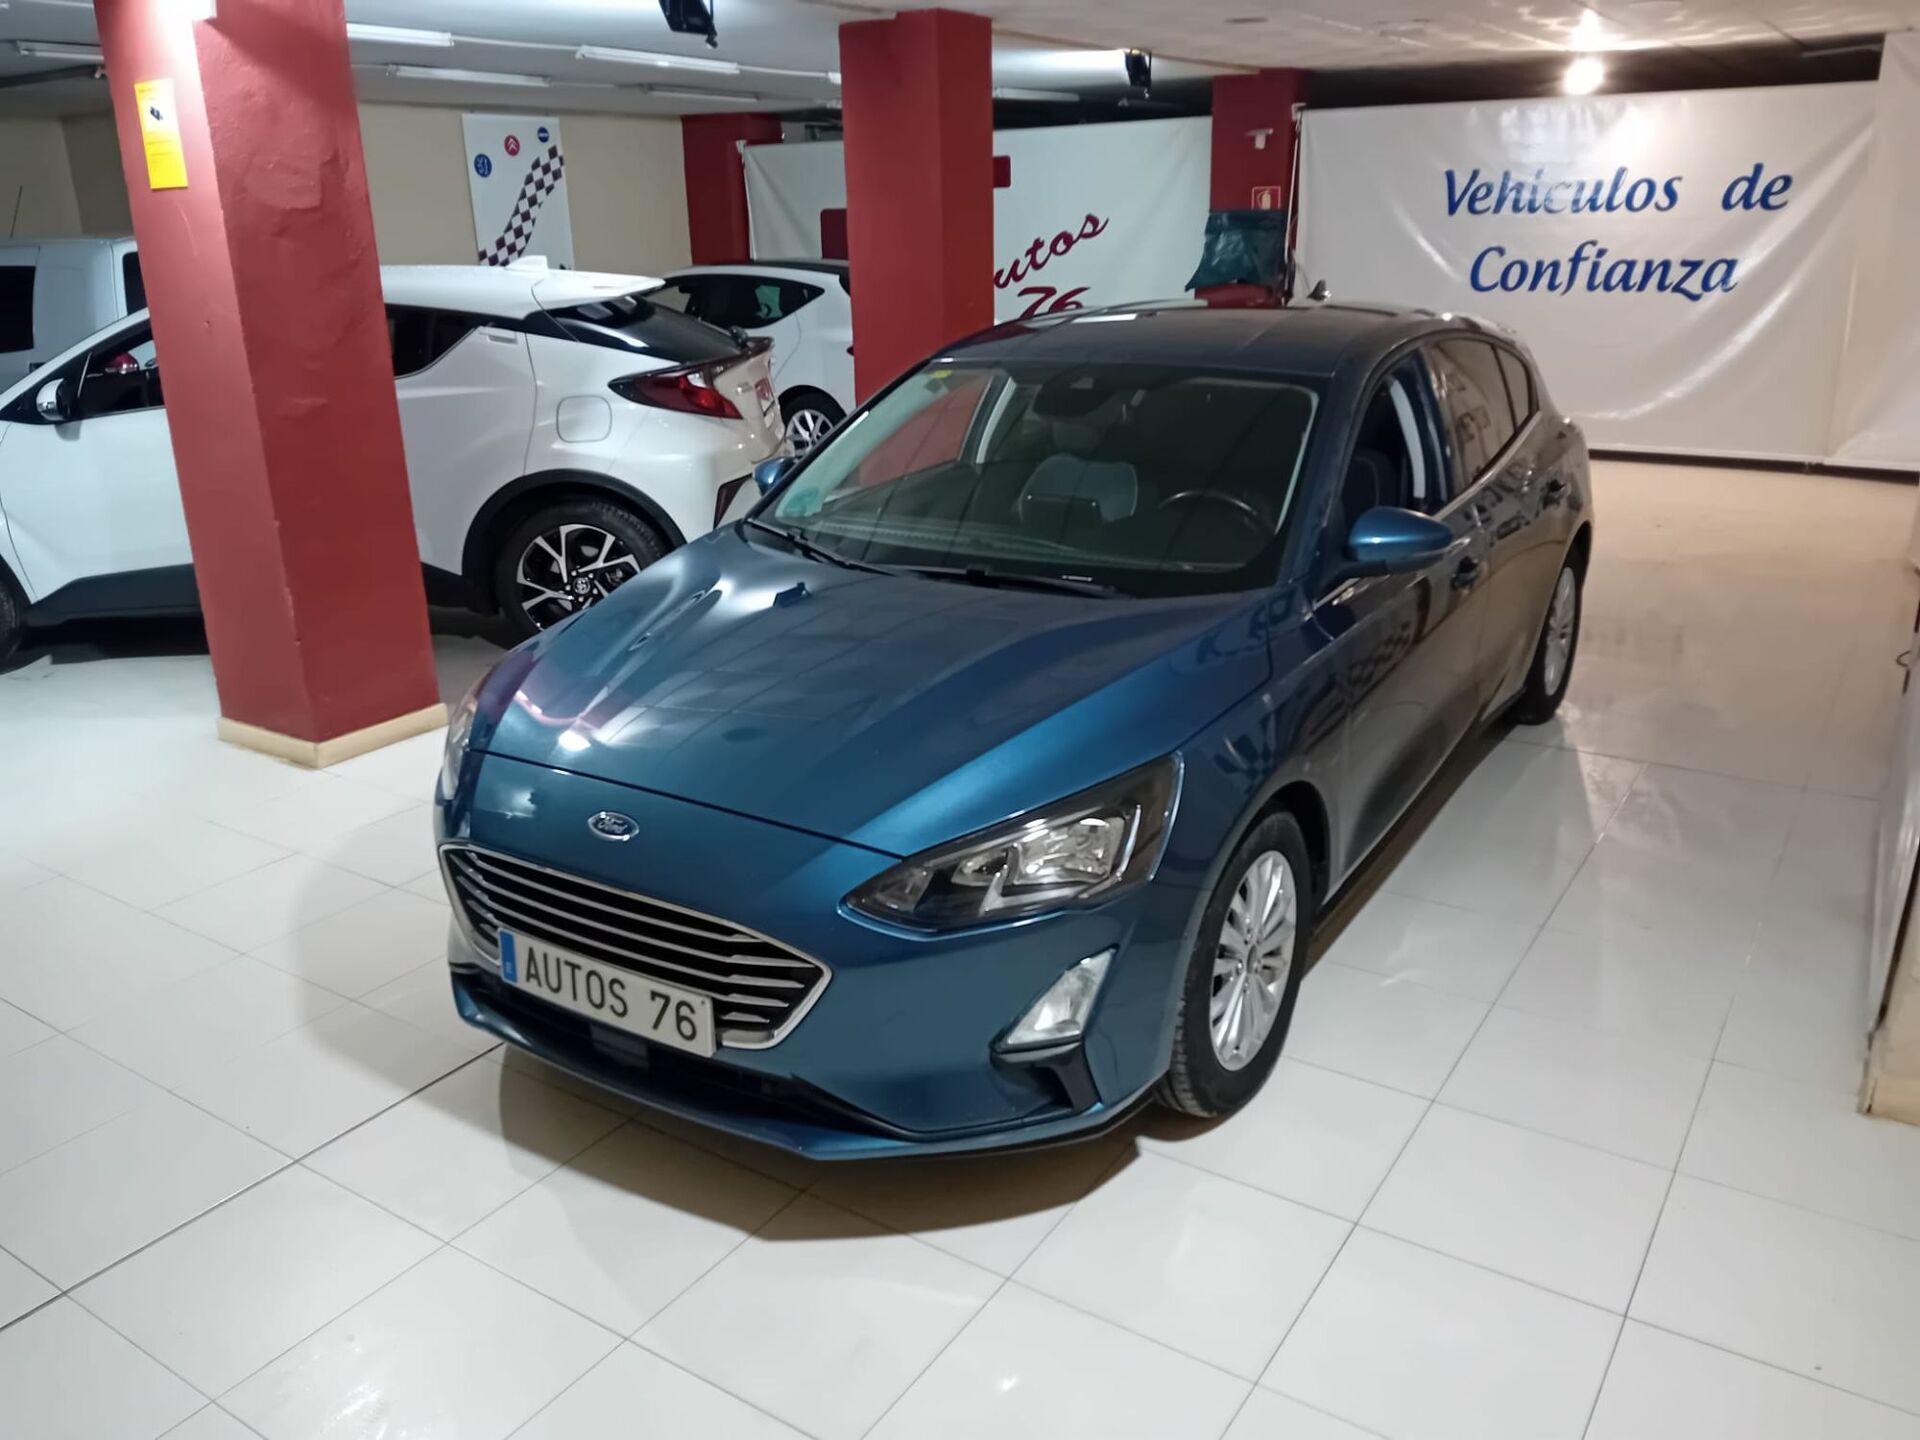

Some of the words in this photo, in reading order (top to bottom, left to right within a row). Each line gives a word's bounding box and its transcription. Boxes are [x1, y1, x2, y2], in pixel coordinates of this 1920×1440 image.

[1721, 162, 1794, 212] de
[994, 213, 1109, 289] utos
[1470, 240, 1739, 301] Confianza
[526, 946, 628, 1018] AUTOS
[651, 989, 697, 1041] 76
